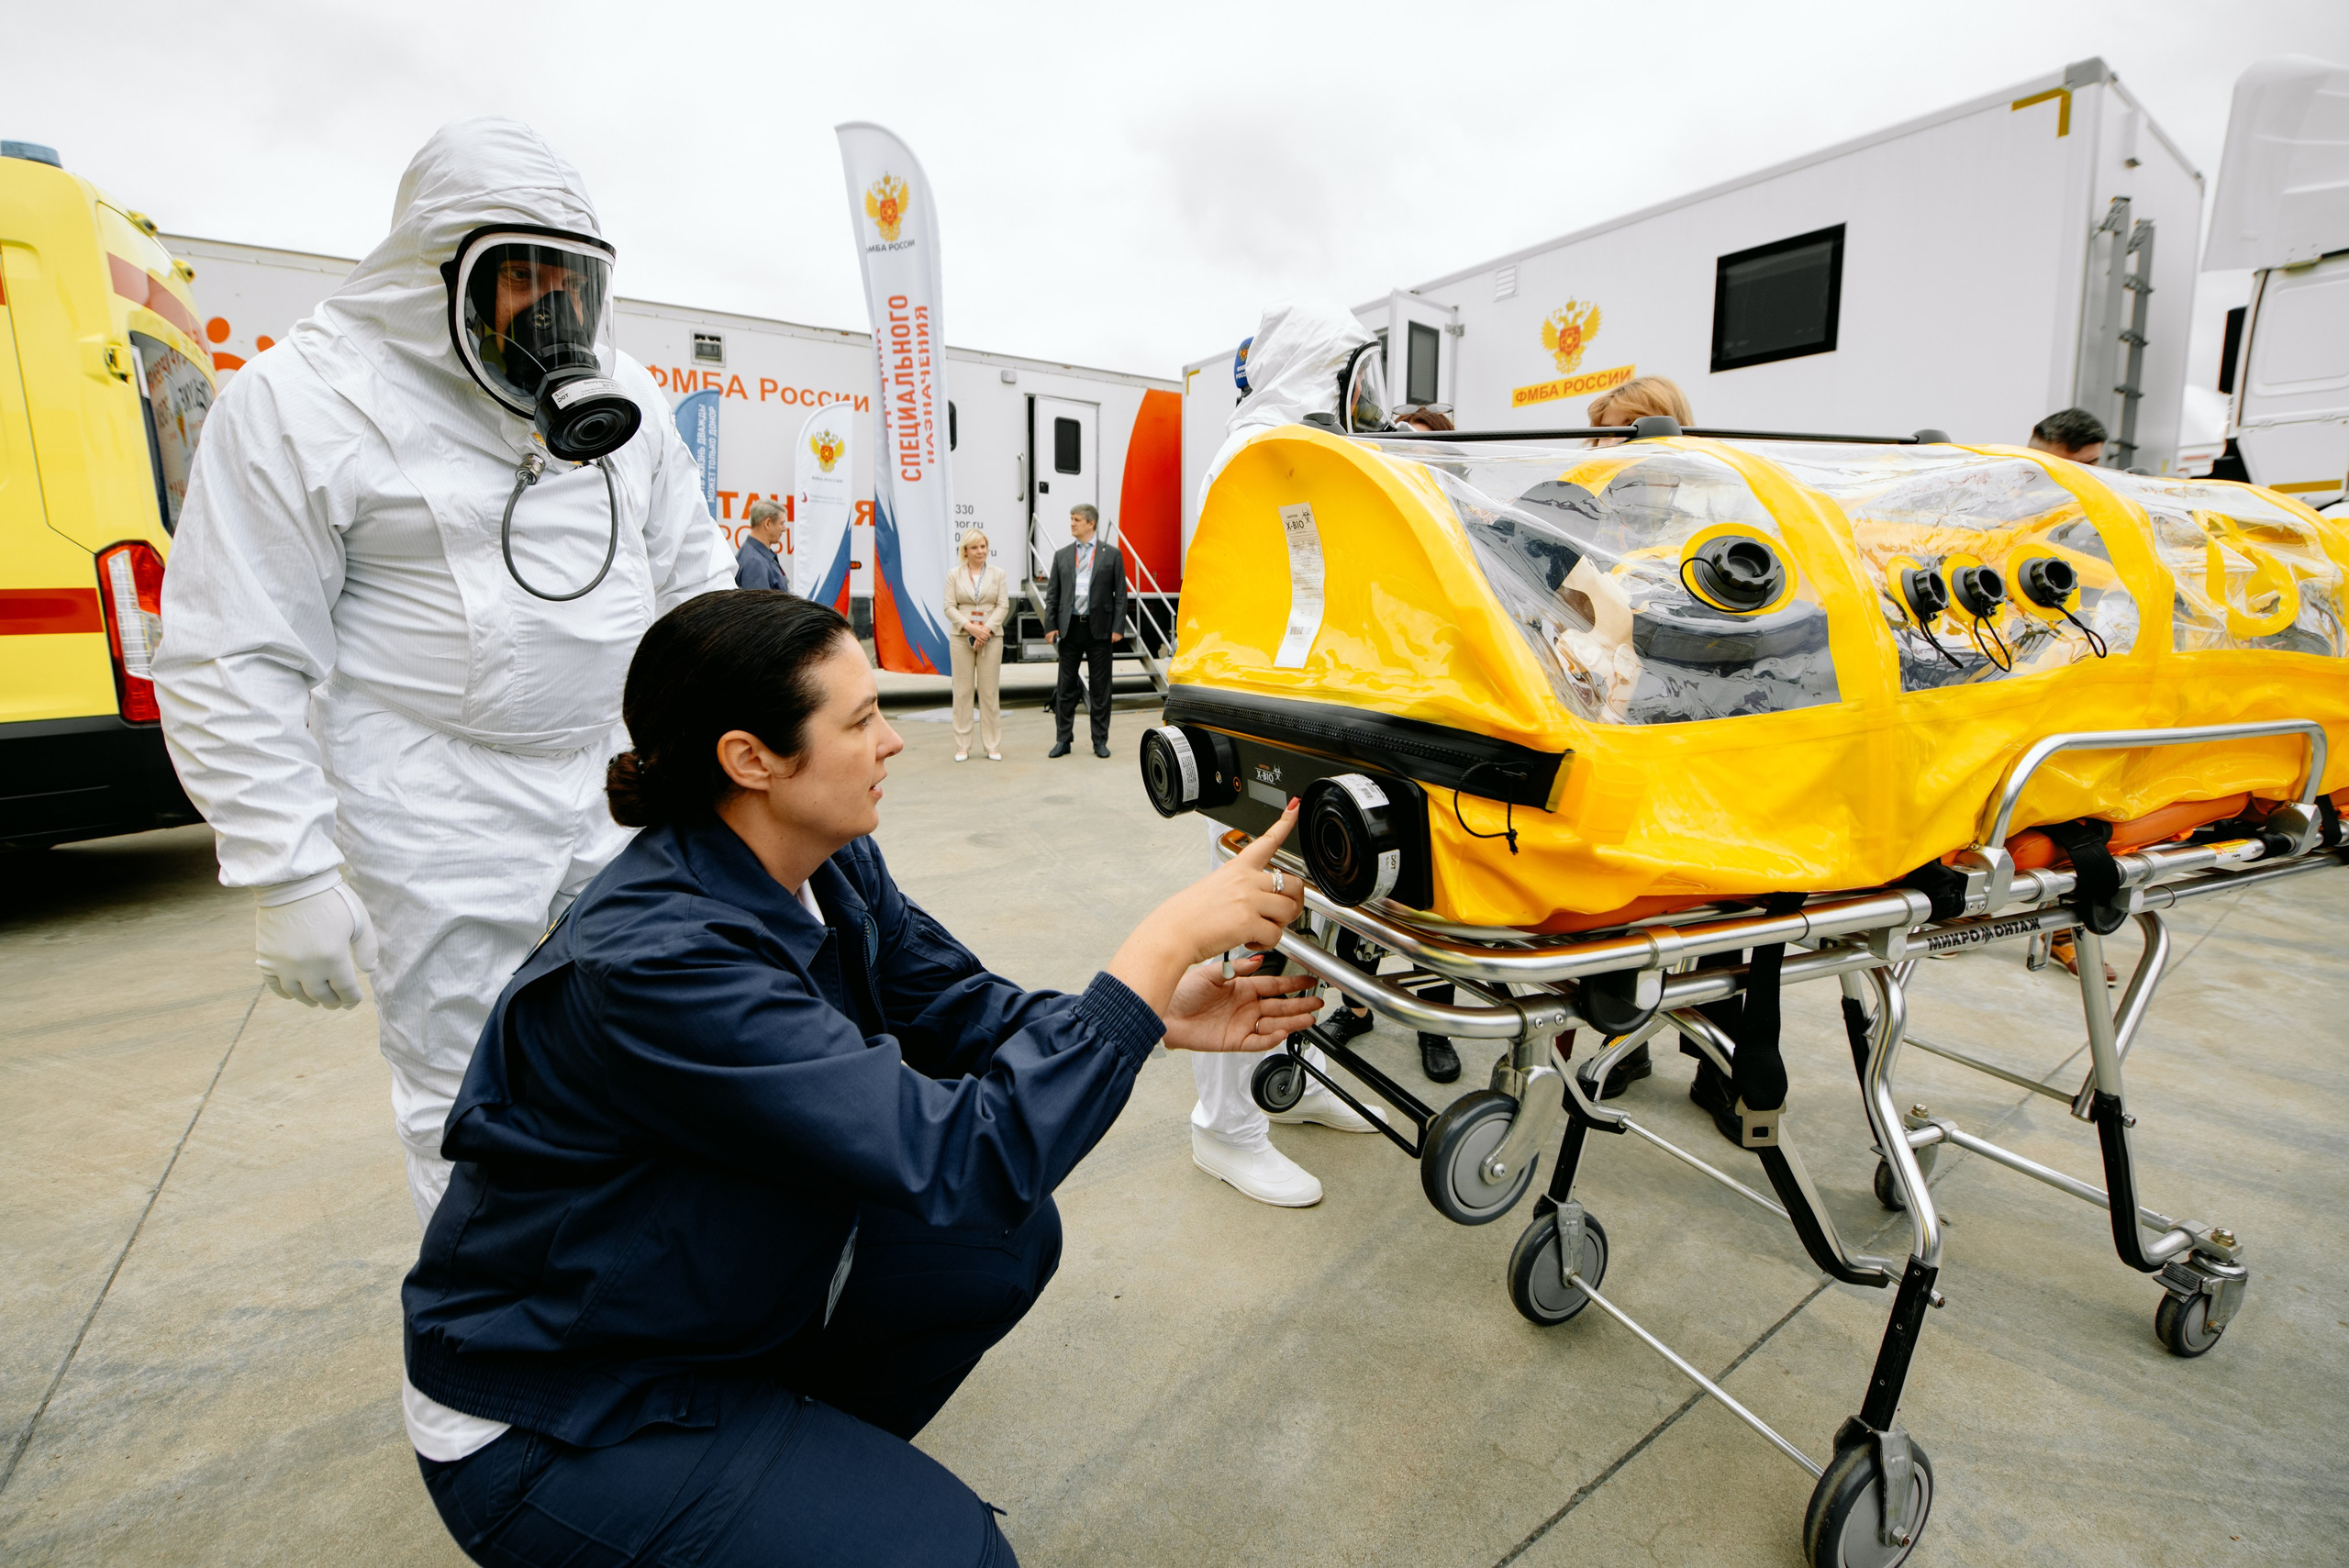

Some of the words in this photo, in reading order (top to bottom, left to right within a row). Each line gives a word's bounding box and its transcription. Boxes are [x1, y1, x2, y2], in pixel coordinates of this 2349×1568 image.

[888, 239, 915, 250] РОССИИ
[759, 377, 869, 413] России
[888, 295, 922, 482] СПЕЦИАЛЬНОГО
[915, 306, 934, 464] НАЗНАЧЕНИЯ
[1515, 384, 1559, 403] ФМБА
[1564, 369, 1631, 395] РОССИИ
[697, 404, 706, 446] ДВАЖДЫ
[708, 406, 718, 437] ДОНОР
[708, 438, 717, 470] ТОЛЬКО
[707, 472, 716, 504] МОЖЕТ
[1286, 519, 1305, 530] X-BIO
[1256, 769, 1274, 783] X-BIO
